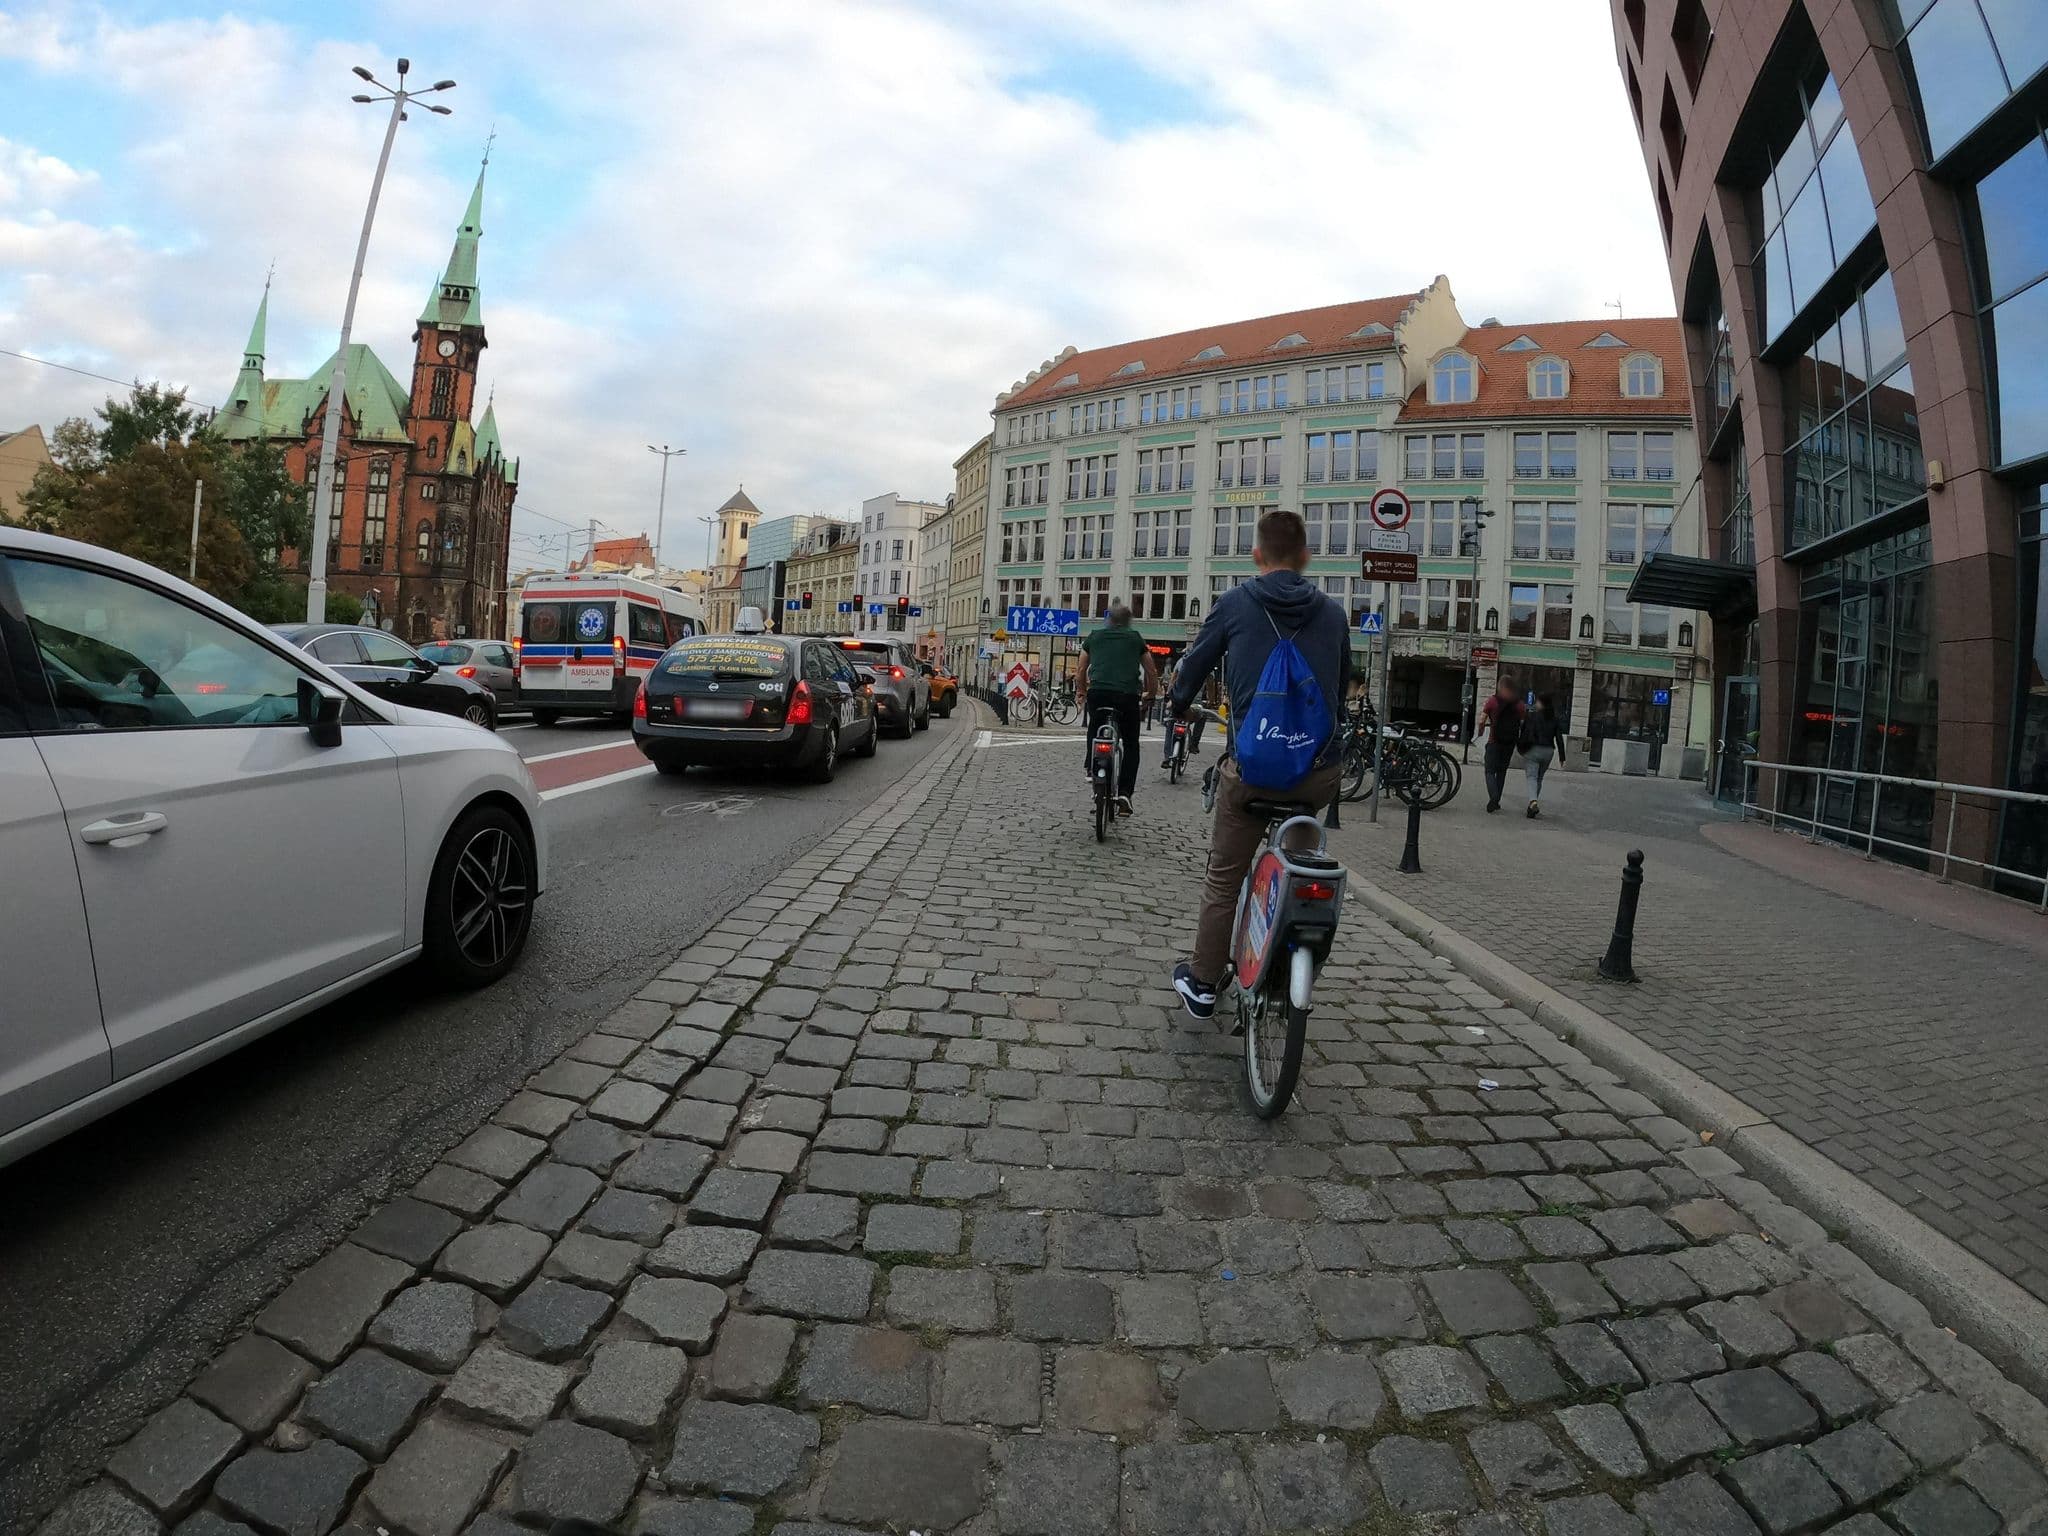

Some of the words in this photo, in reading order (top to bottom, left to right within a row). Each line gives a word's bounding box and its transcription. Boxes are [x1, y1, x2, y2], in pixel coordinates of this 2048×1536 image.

[1008, 638, 1026, 649] hebe
[687, 655, 707, 663] 575
[709, 655, 731, 663] 256
[735, 655, 759, 664] 496
[571, 668, 610, 677] AMBULANS
[759, 682, 784, 692] opti
